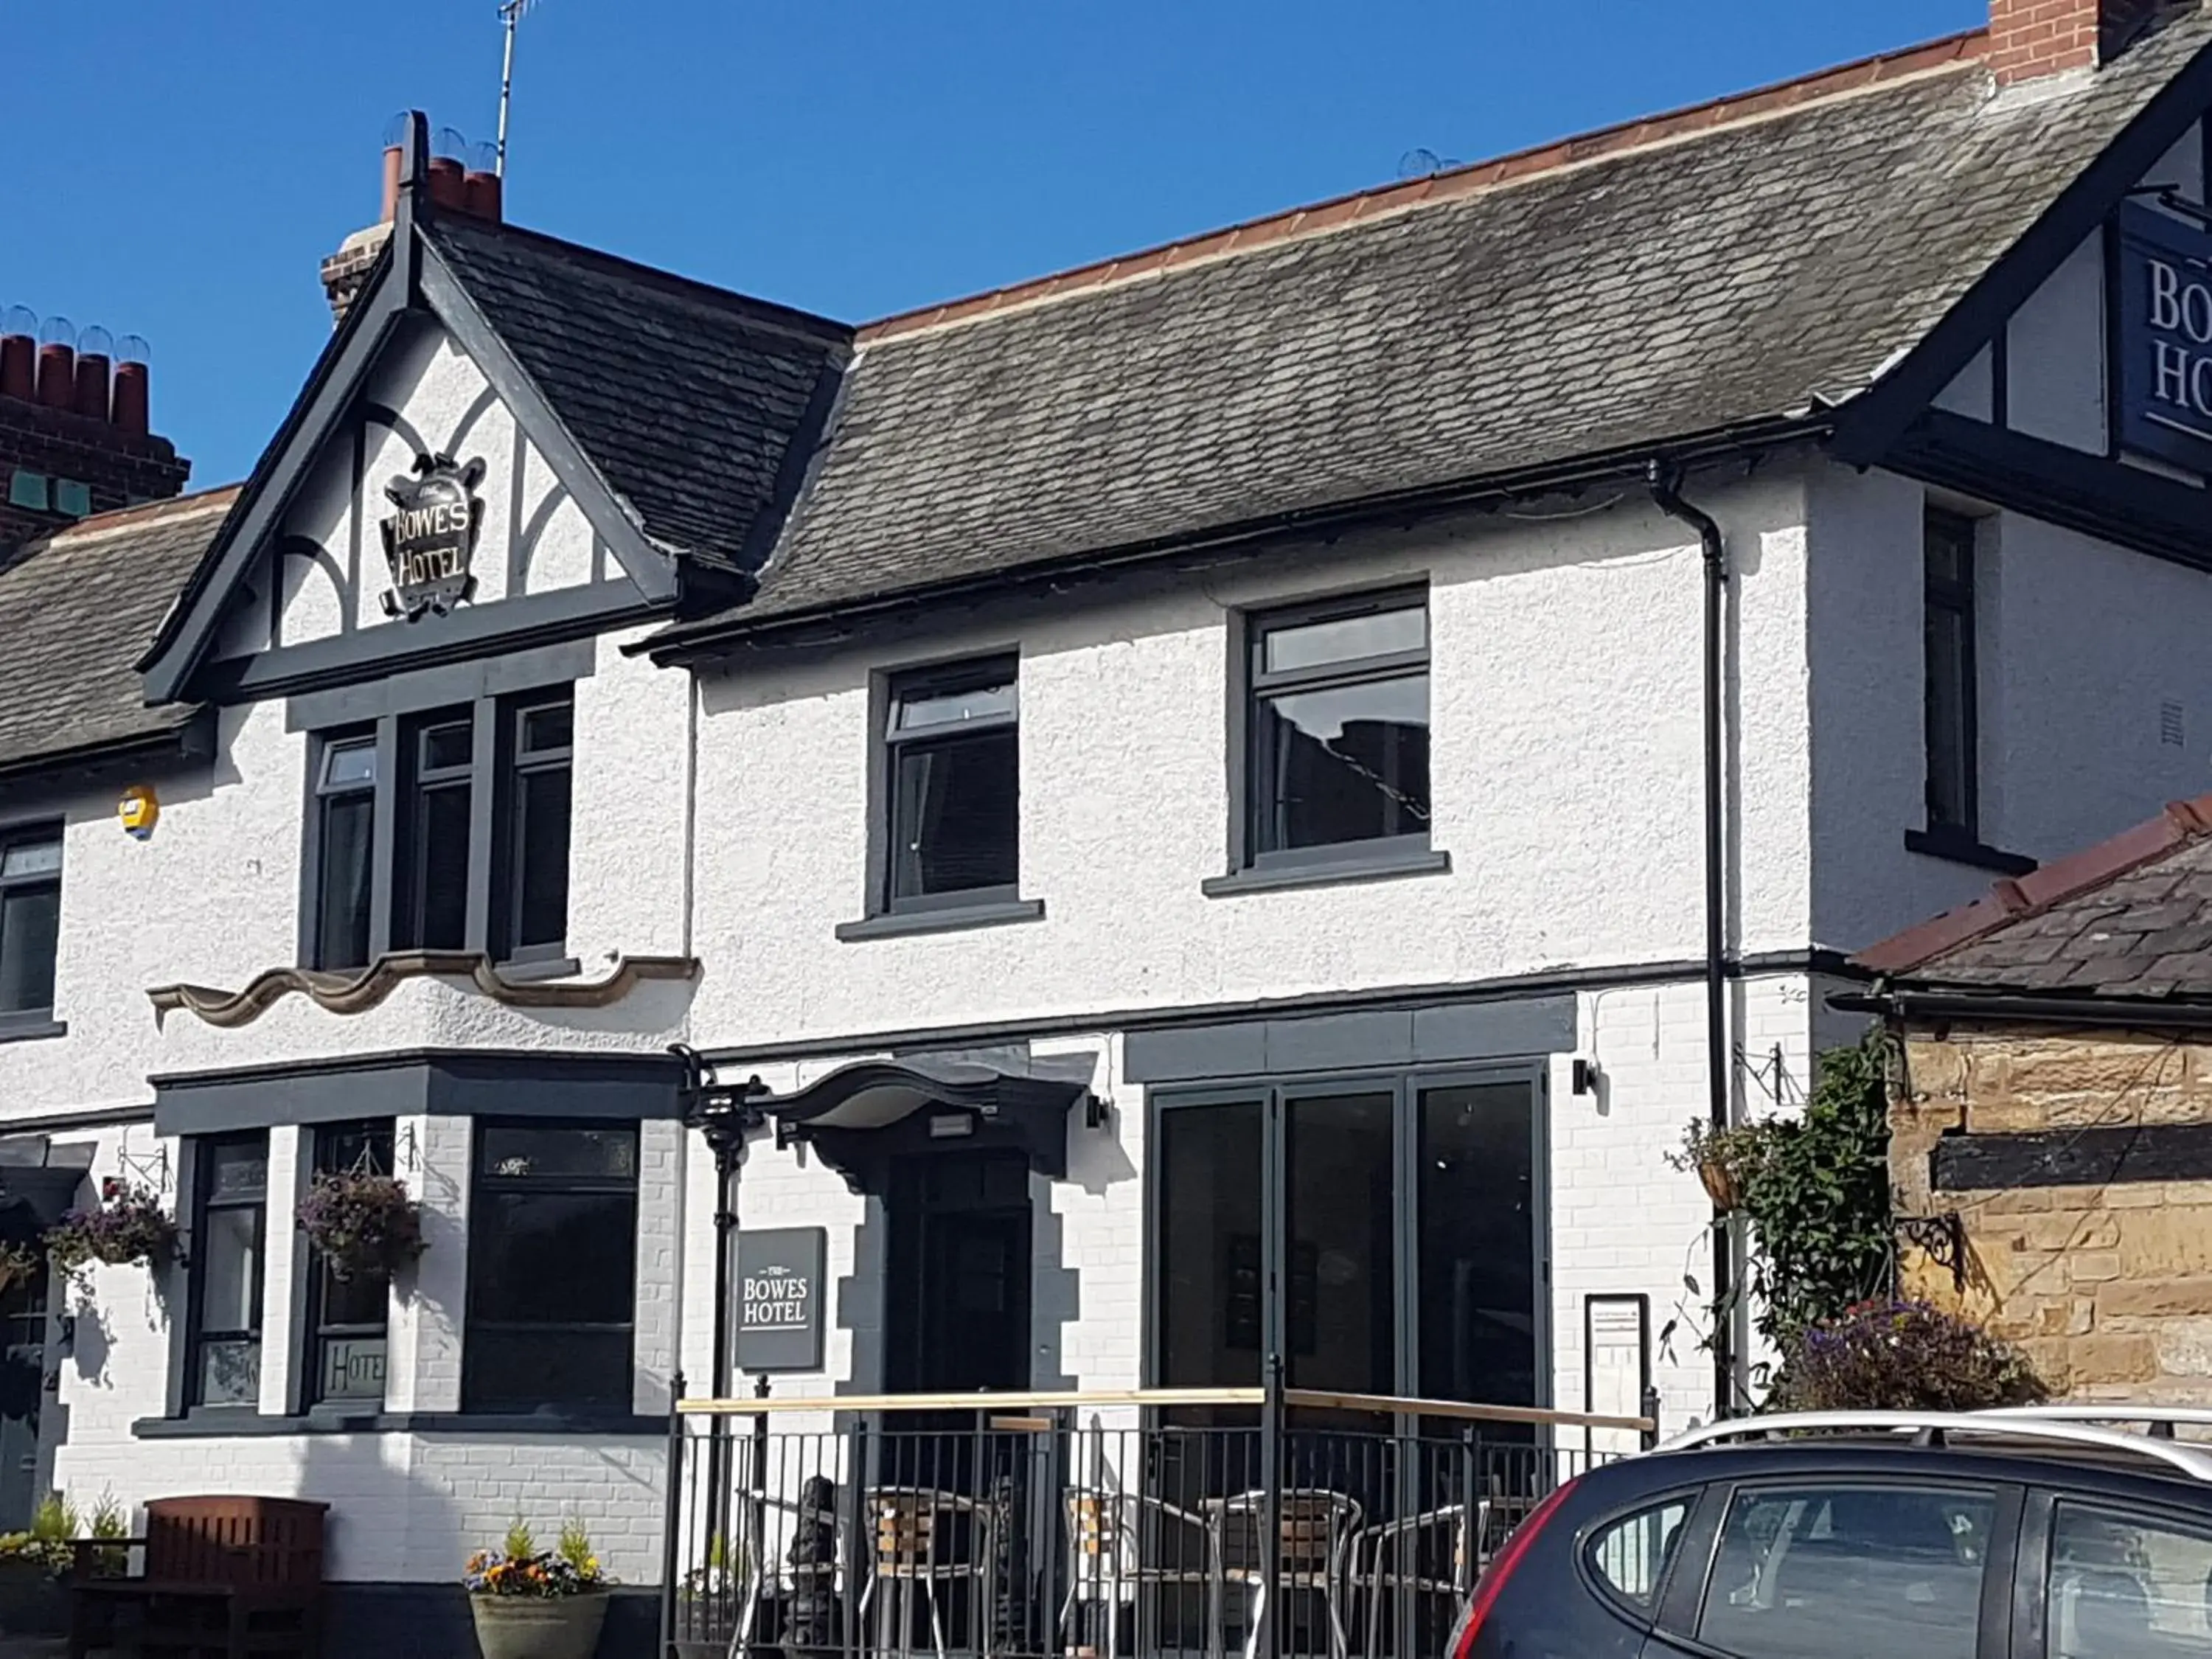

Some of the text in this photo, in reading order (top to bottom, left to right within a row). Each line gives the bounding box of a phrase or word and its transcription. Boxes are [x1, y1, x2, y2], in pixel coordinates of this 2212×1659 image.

[395, 502, 469, 545] BOWES
[397, 546, 465, 587] HOTEL
[742, 1277, 808, 1301] BOWES
[743, 1301, 807, 1324] HOTEL
